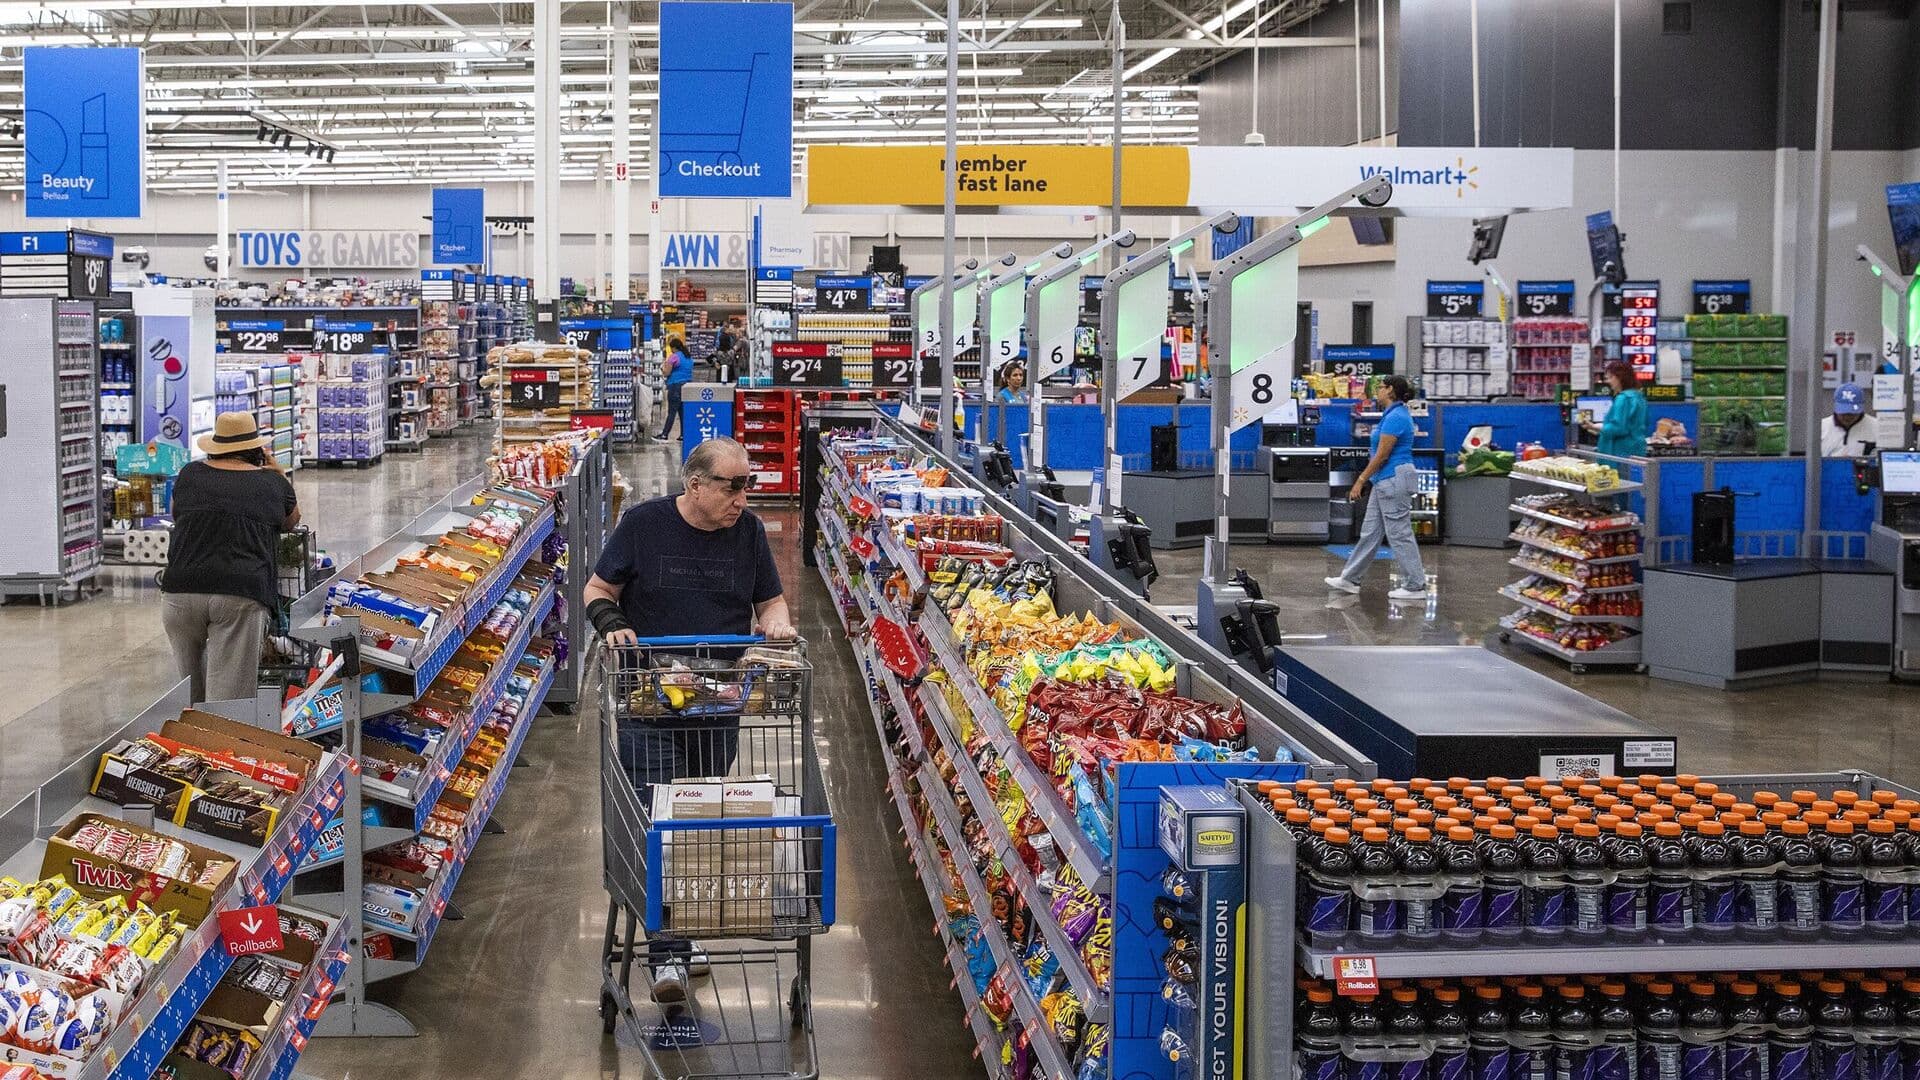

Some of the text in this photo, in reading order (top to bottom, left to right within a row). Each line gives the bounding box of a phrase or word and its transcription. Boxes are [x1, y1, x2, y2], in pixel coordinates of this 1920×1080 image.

[678, 160, 761, 177] Checkout
[42, 174, 94, 191] Beauty
[958, 174, 1047, 191] fast lane
[22, 236, 38, 251] F1
[239, 232, 416, 266] TOYS & GAMES
[661, 234, 719, 268] AWN
[769, 246, 802, 254] Pharmacy
[767, 270, 778, 278] G1
[1635, 298, 1652, 308] 54
[1627, 316, 1651, 327] 203
[926, 331, 935, 343] 3
[955, 335, 966, 348] 4
[1630, 335, 1651, 346] 150
[1000, 341, 1011, 356] 5
[1051, 346, 1063, 364] 6
[1886, 342, 1900, 357] 34
[1634, 354, 1651, 365] 27
[1132, 357, 1148, 380] 7
[1251, 374, 1273, 404] 8
[126, 775, 166, 800] HERSHEY'S
[197, 799, 246, 823] HERSHEY'S
[171, 884, 189, 897] 24
[229, 936, 279, 954] Rollback
[1215, 899, 1228, 977] VISION!
[1347, 981, 1377, 989] Rollback
[1213, 981, 1227, 1041] YOUR
